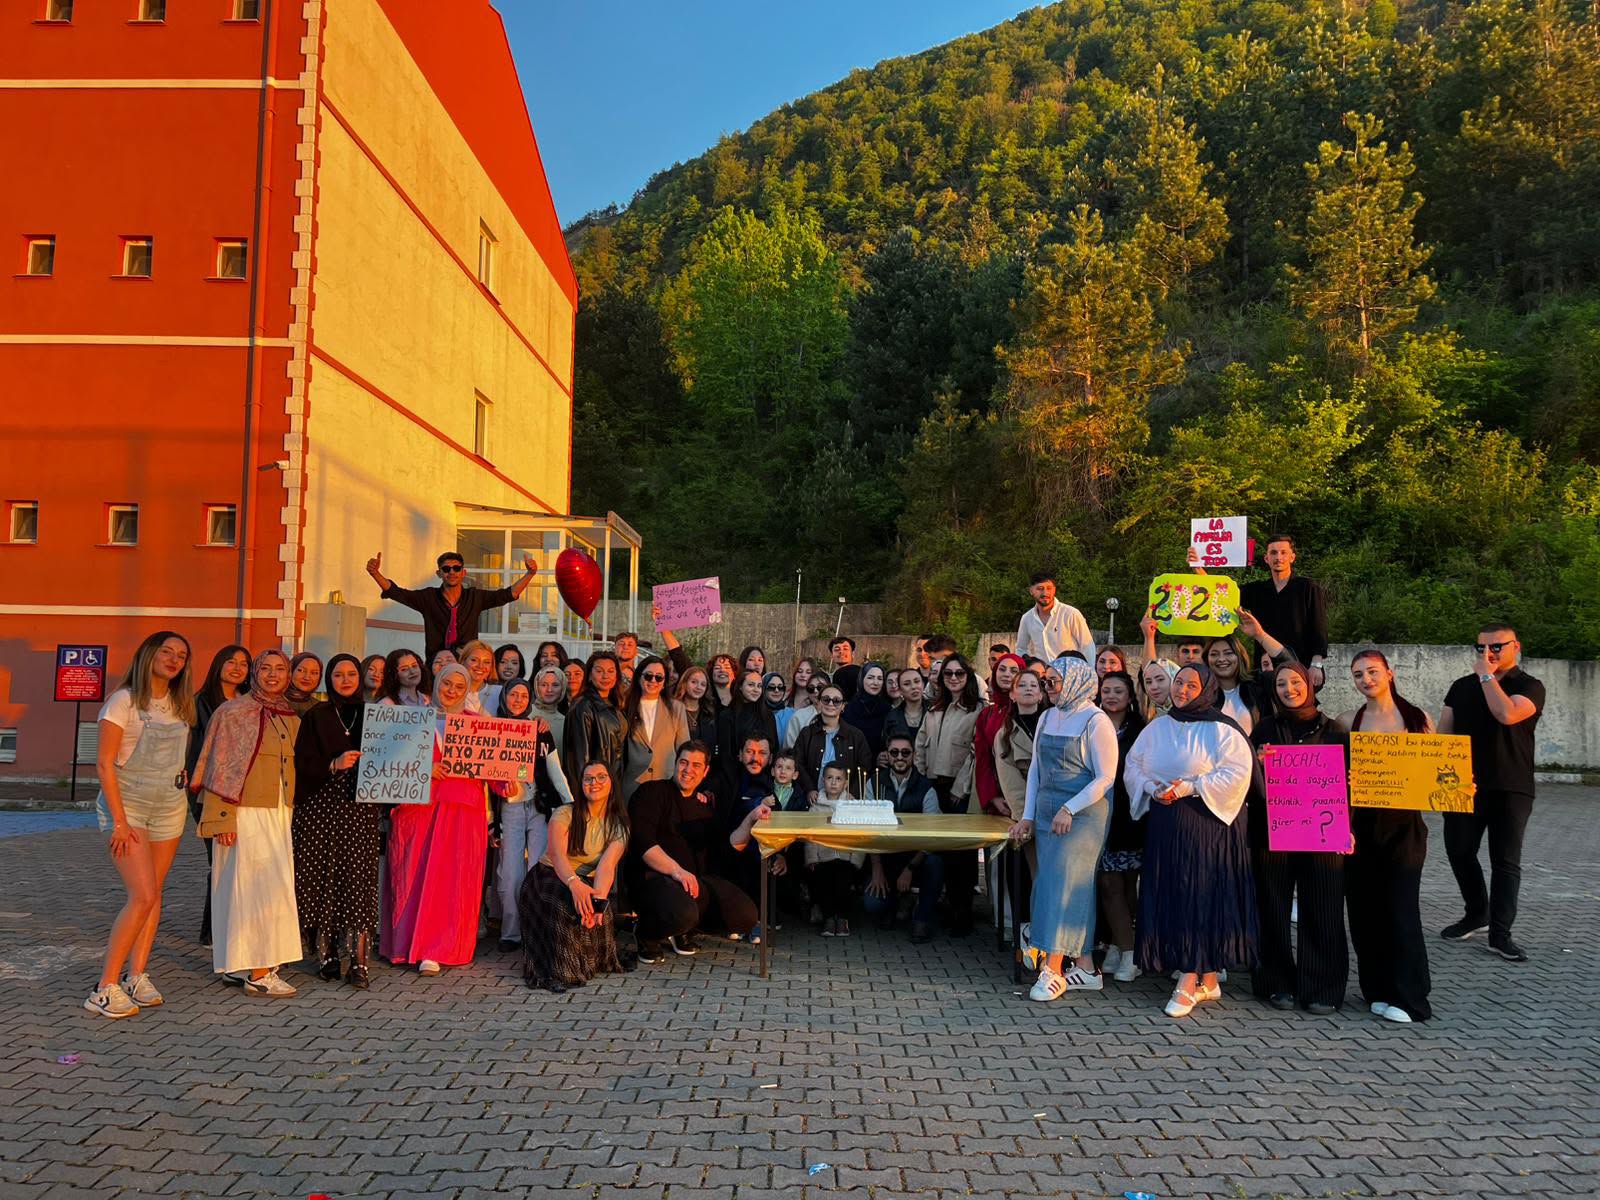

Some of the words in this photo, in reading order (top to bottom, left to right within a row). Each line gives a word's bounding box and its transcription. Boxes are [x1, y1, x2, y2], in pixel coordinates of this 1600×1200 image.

[1209, 518, 1223, 530] LA
[1205, 543, 1222, 555] ES
[65, 651, 78, 664] P
[443, 745, 473, 759] MYO
[478, 748, 495, 760] AZ
[499, 750, 534, 763] OLSUN
[362, 760, 429, 784] BAHAR
[1286, 775, 1298, 785] da
[1307, 775, 1340, 789] sosyal
[1272, 818, 1294, 832] girer
